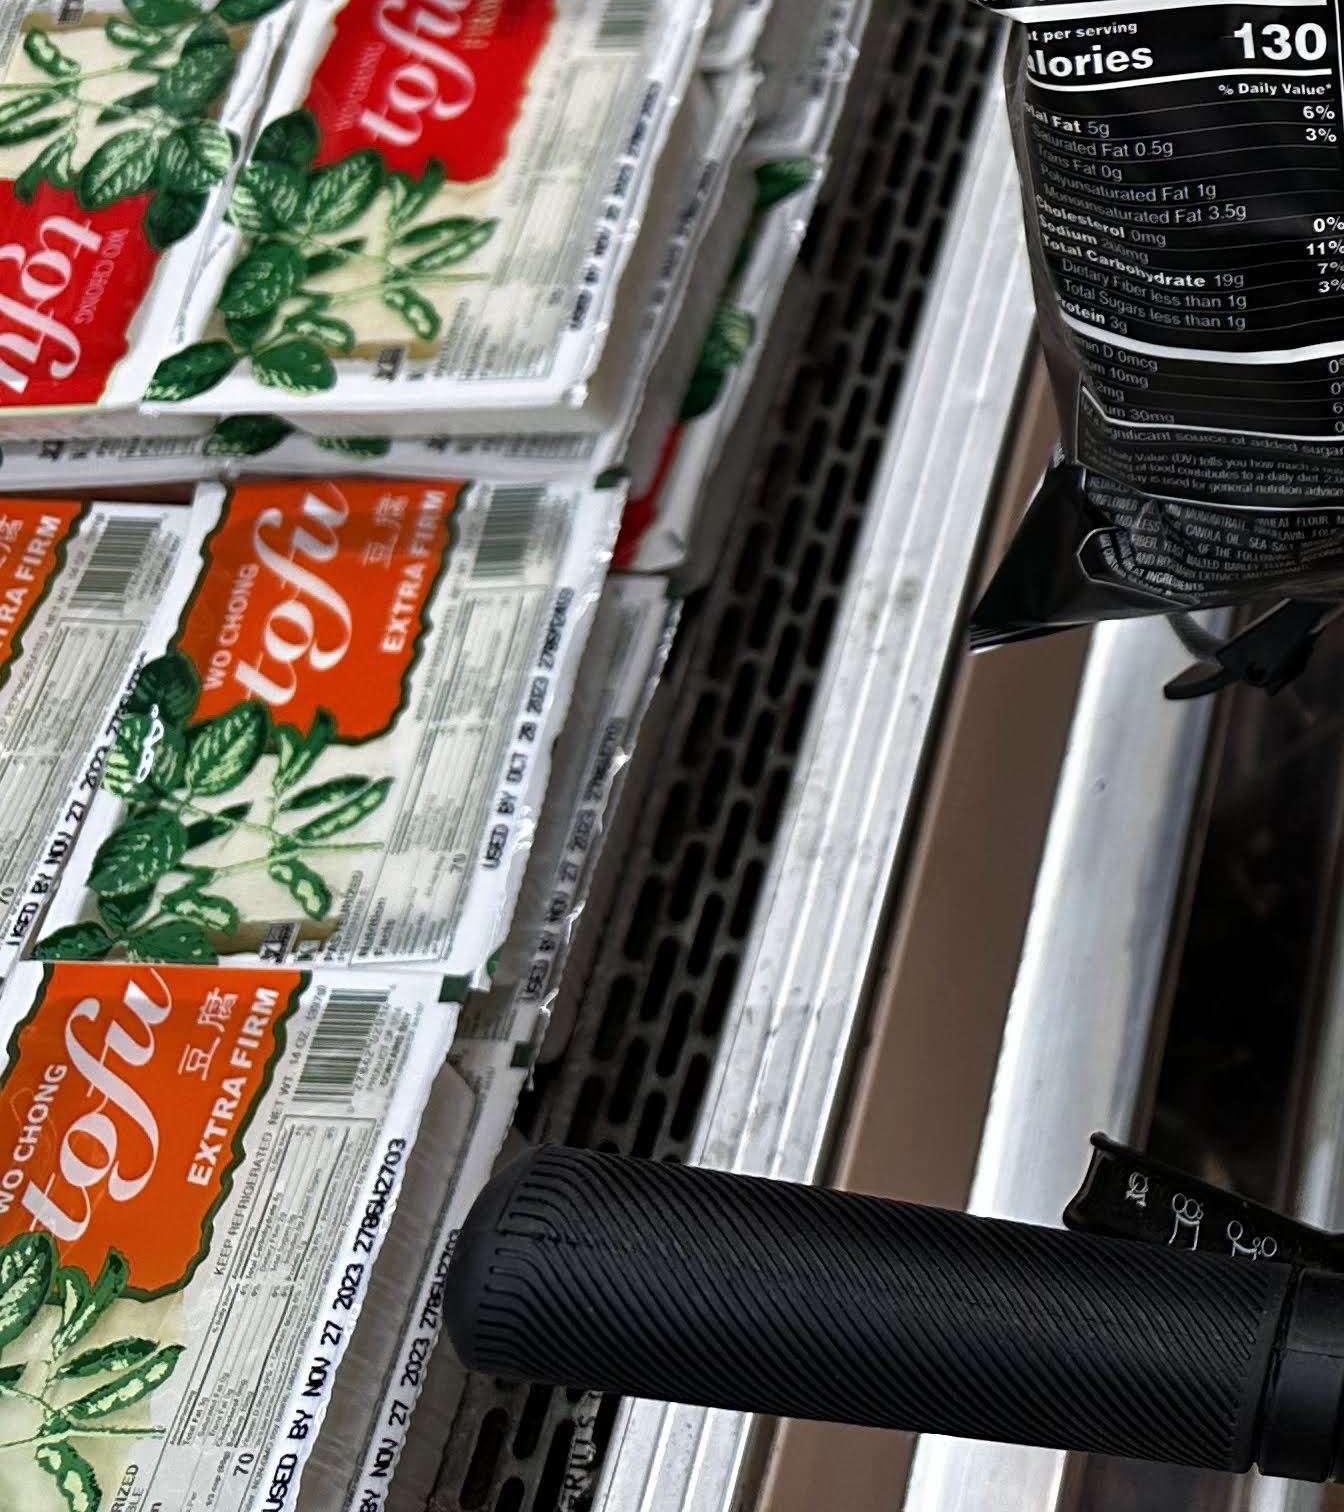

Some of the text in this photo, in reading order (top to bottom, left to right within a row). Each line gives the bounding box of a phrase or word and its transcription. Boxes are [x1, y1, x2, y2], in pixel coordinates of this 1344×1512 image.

[1043, 20, 1139, 45] per serving
[1233, 21, 1329, 63] 130
[1238, 81, 1279, 96] Daily
[1052, 105, 1336, 139] Fat 5g 6%
[1102, 142, 1130, 159] Fat
[1135, 141, 1174, 159] 0.5g
[1305, 127, 1338, 143] 3%
[1101, 165, 1123, 183] 0g
[1161, 185, 1191, 201] Fat
[1197, 184, 1218, 201] 1g
[1175, 208, 1203, 224] Fat
[1208, 203, 1248, 221] 3.5g
[1130, 228, 1168, 249] 0mg
[1042, 234, 1083, 259] Total
[1087, 248, 1206, 289] Carbohydrate
[1214, 274, 1245, 290] 19g
[1100, 293, 1247, 332] Sugars less than 1g
[1151, 288, 1182, 307] less
[1185, 294, 1222, 309] than
[1228, 295, 1248, 311] 1g
[1109, 316, 1129, 335] 3g
[1117, 350, 1159, 373] 0mcg
[15, 514, 63, 582] FIRM
[381, 490, 447, 653] EXTRA FIRM
[234, 481, 353, 706] tofu
[204, 563, 260, 691] WO CHONG
[497, 790, 518, 815] BY
[178, 987, 240, 1082] 豆腐
[21, 967, 173, 1242] tofu
[187, 987, 280, 1187] EXTRA FIRM
[14, 1064, 68, 1162] CHONG
[214, 1131, 274, 1277] KEEP REFRIGERATED
[262, 1452, 299, 1512] USED
[287, 1409, 314, 1441] BY
[301, 1356, 332, 1397] NOV
[321, 1319, 344, 1346] 27
[333, 1262, 365, 1312] 2023
[360, 1337, 431, 1512] BY NOV 27 2023
[233, 1452, 255, 1477] 70
